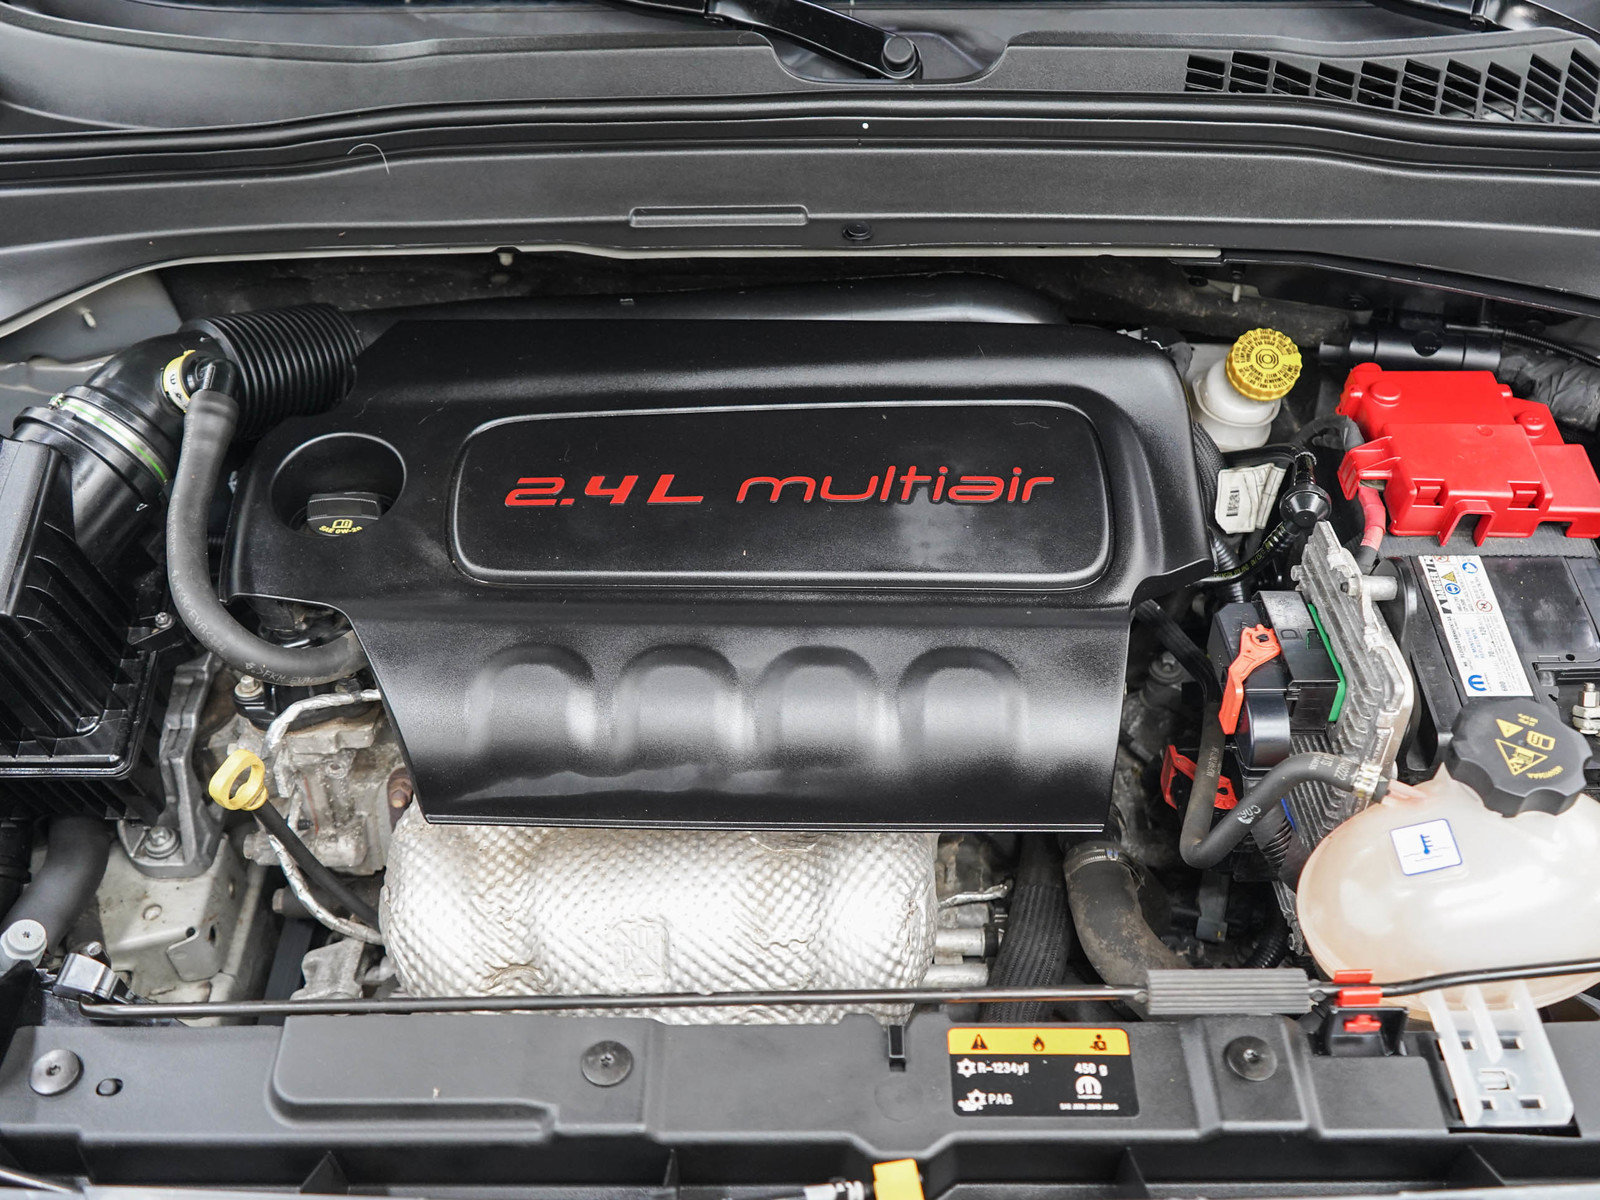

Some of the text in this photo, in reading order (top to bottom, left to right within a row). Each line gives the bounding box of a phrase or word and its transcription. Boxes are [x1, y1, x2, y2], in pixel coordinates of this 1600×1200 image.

[736, 465, 1055, 504] multiair
[1074, 1062, 1097, 1075] 450
[987, 1093, 1013, 1105] PAG
